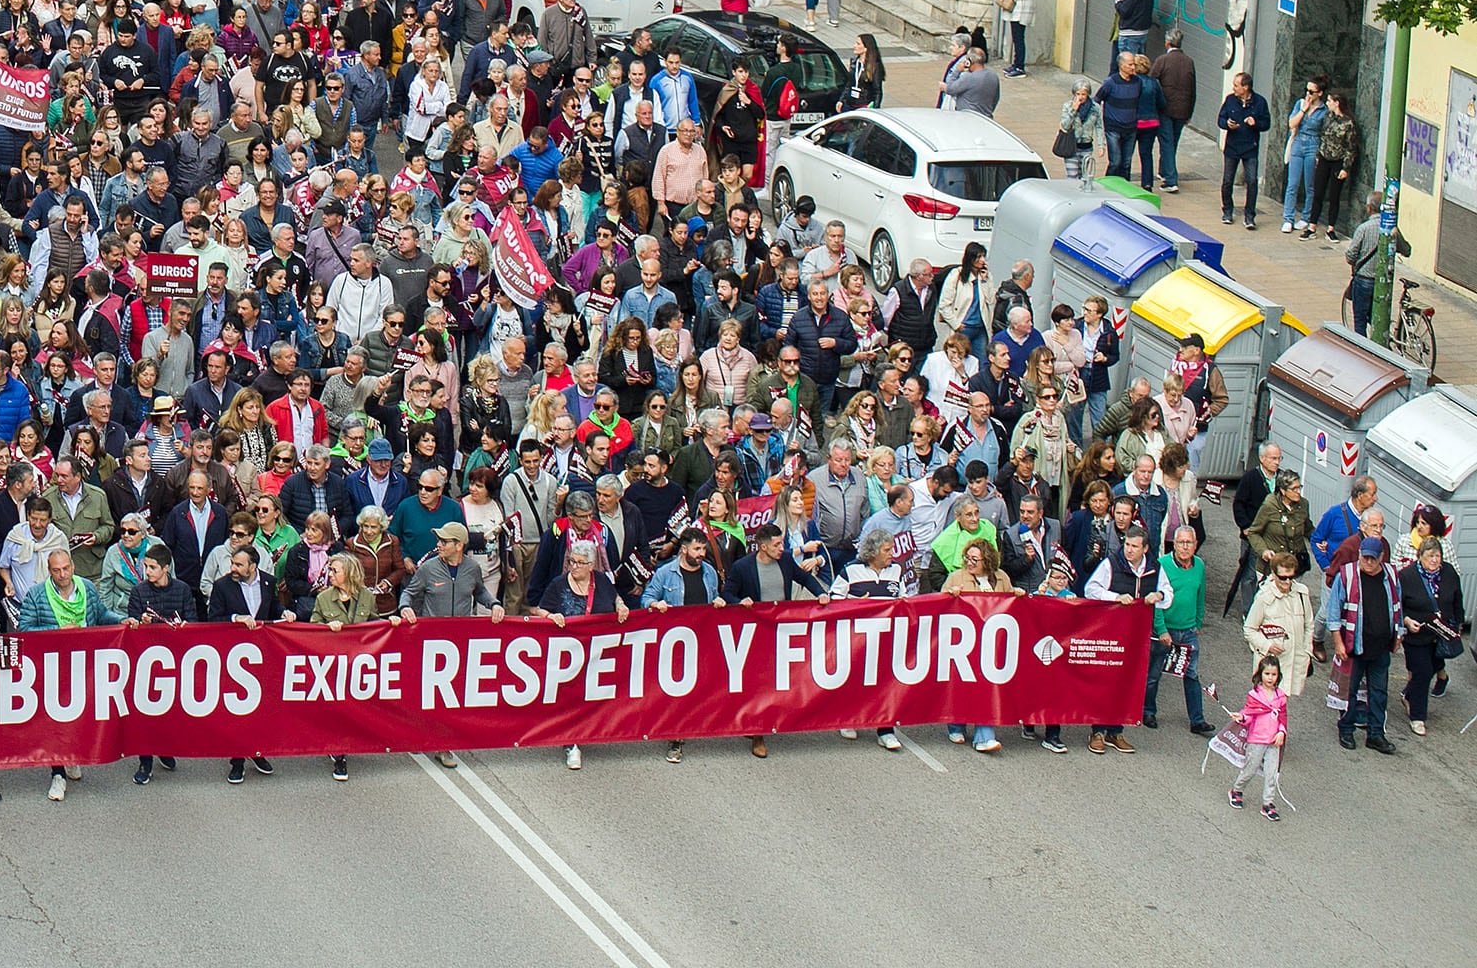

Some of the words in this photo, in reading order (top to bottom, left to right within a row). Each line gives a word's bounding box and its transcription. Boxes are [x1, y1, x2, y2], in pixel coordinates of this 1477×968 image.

[151, 264, 195, 278] BURGOS
[282, 652, 402, 702] EXIGE
[422, 626, 698, 710] RESPETO
[717, 623, 757, 693] Y
[775, 613, 1020, 691] FUTURO
